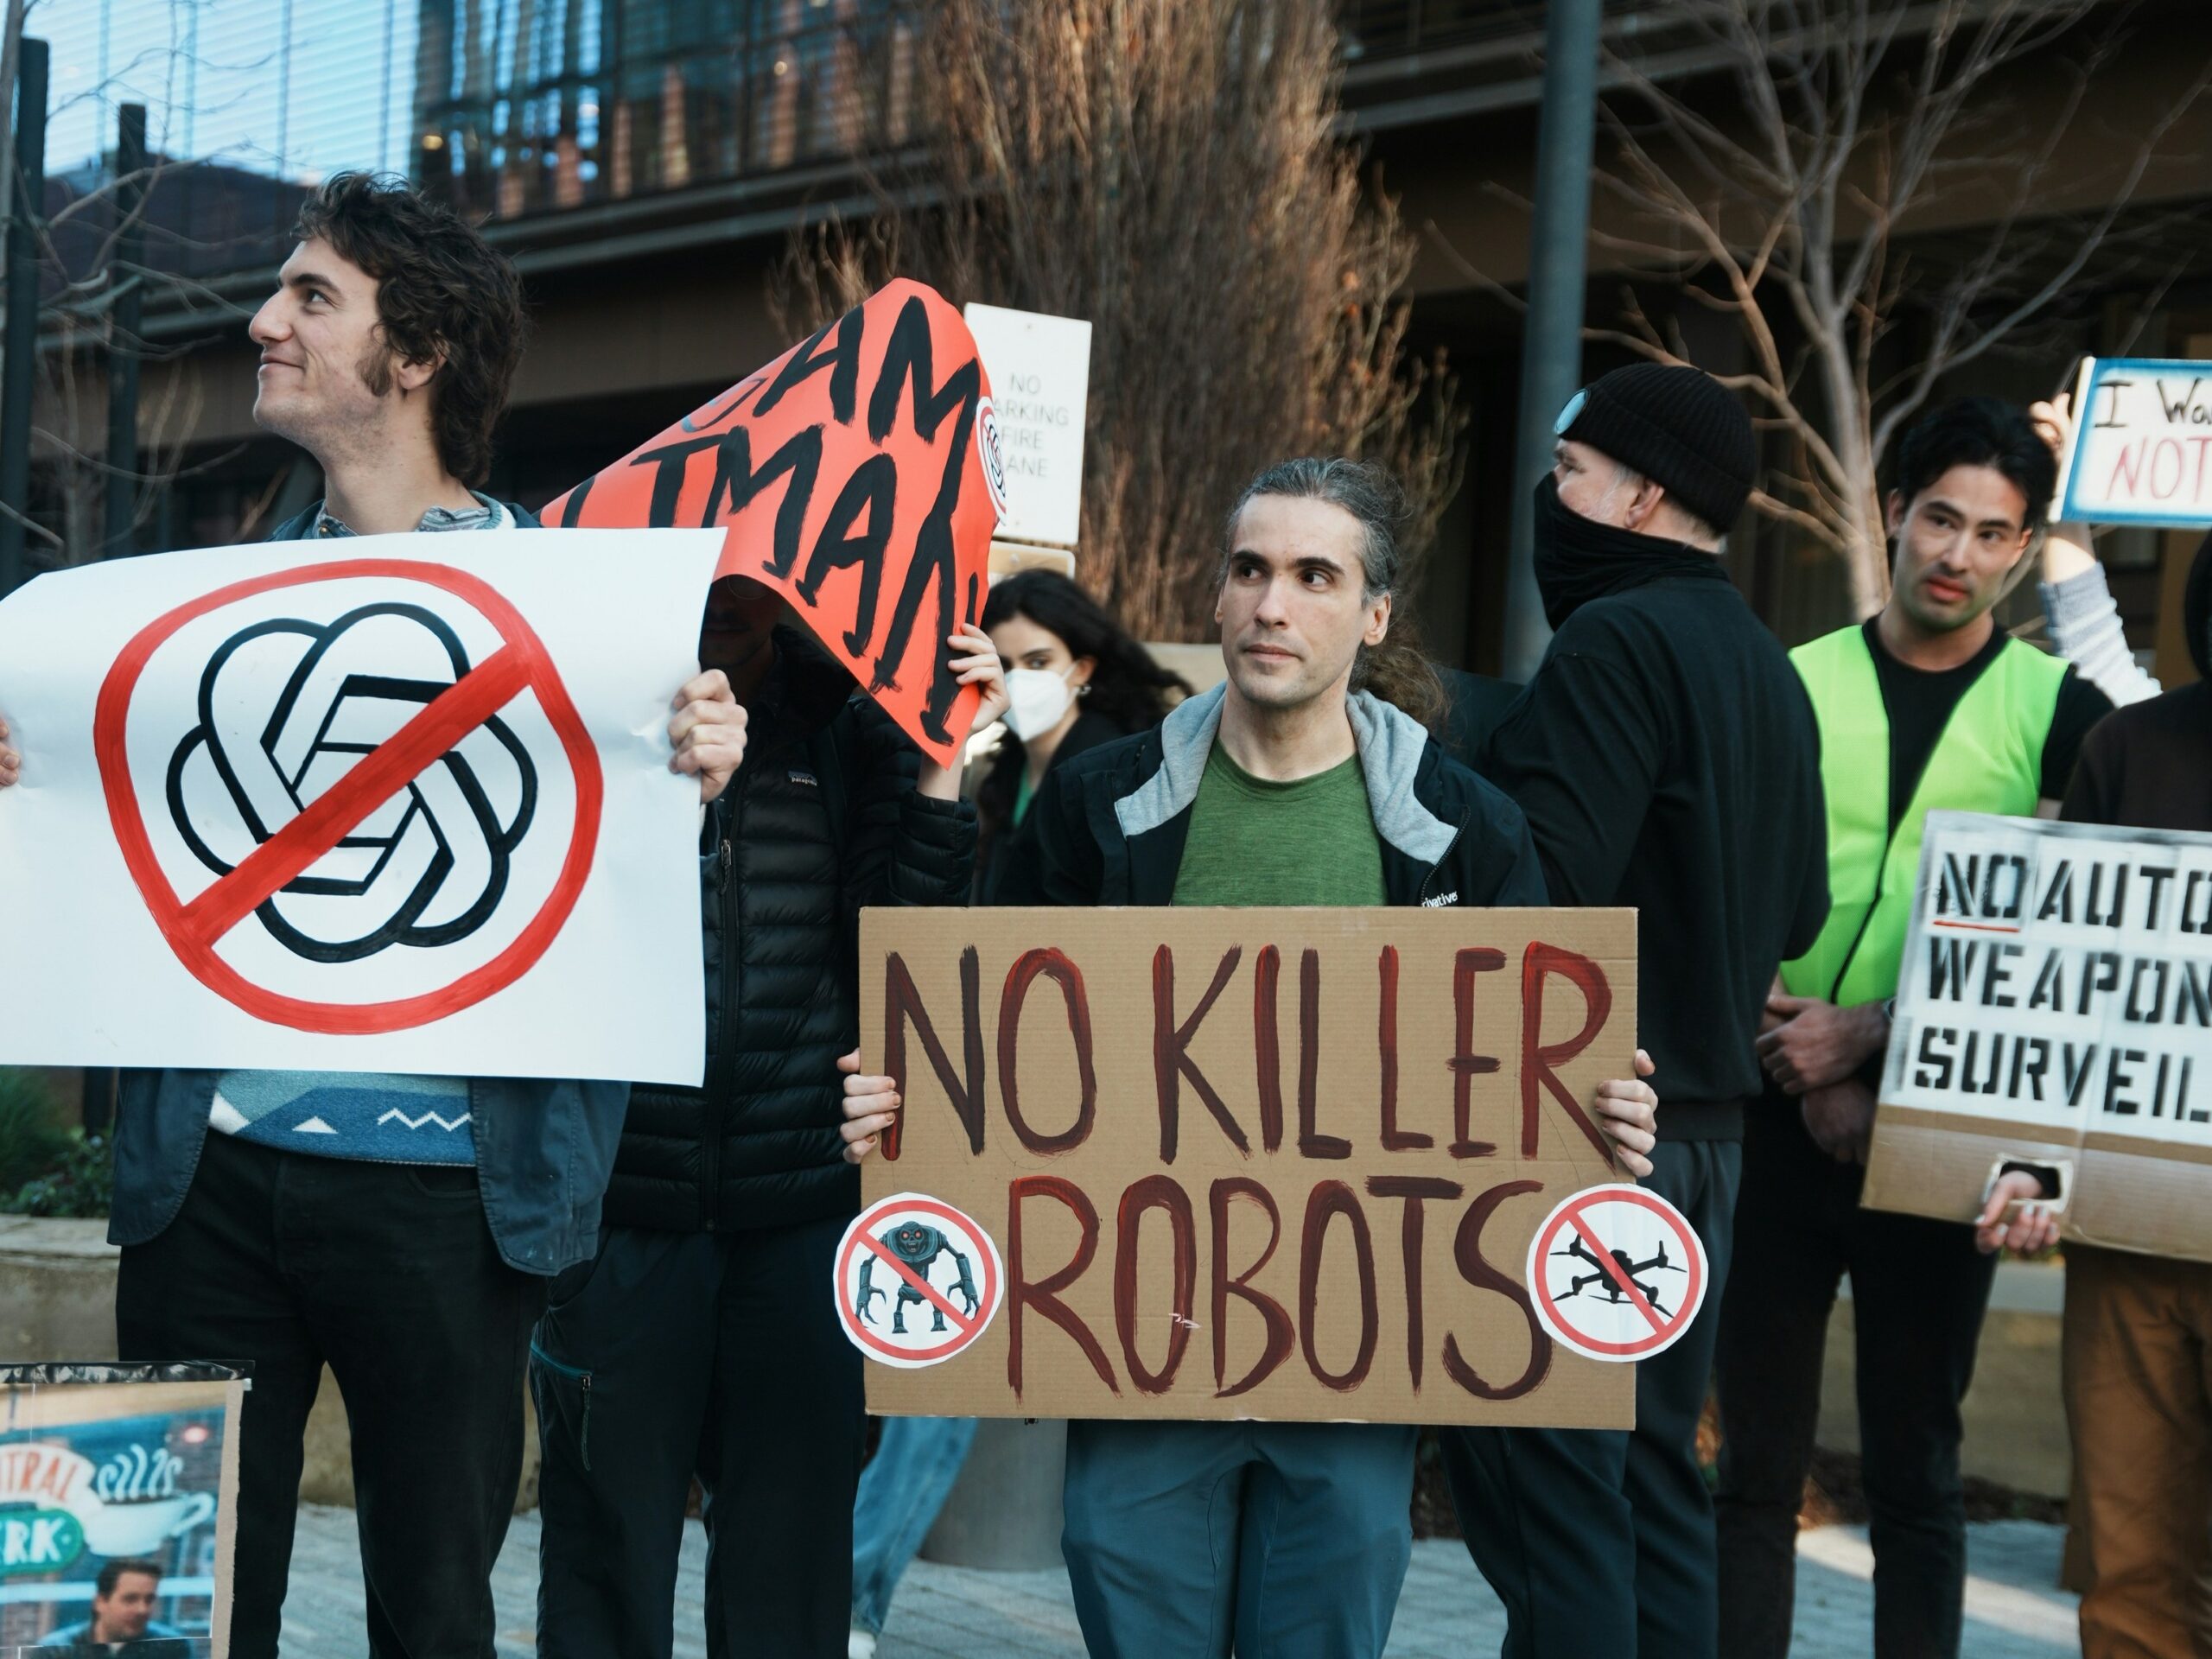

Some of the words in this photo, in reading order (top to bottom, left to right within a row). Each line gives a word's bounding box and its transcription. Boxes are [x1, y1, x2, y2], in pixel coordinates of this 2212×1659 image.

[1009, 372, 1041, 394] NO
[2094, 380, 2133, 428] I
[2156, 377, 2212, 425] Wa
[993, 398, 1069, 426] ARKING
[1001, 426, 1044, 449] FIRE
[1006, 454, 1050, 477] ANE
[2106, 436, 2212, 503] NOT
[560, 423, 978, 747] TMAN
[1421, 891, 1458, 907] rivative
[1937, 852, 2028, 919] NO
[1929, 937, 2212, 1027] WEAPON
[881, 944, 1097, 1160] NO
[1153, 941, 1614, 1175] KILLER
[1007, 1174, 1554, 1407] ROBOTS
[2, 1452, 78, 1501] TRAL
[0, 1518, 66, 1566] RK
